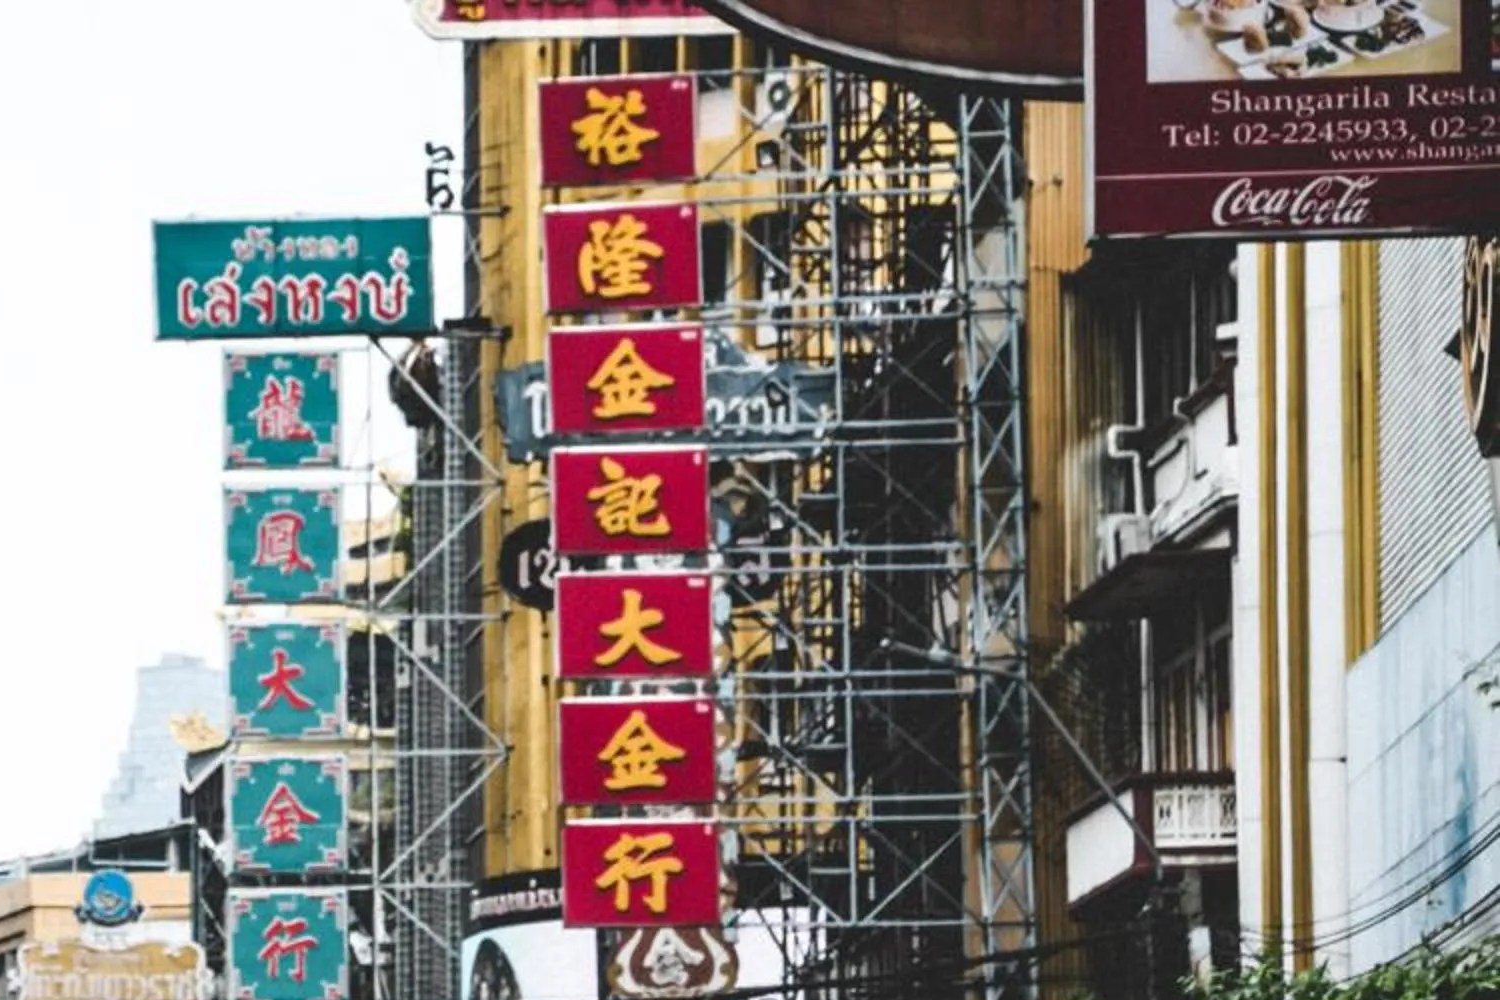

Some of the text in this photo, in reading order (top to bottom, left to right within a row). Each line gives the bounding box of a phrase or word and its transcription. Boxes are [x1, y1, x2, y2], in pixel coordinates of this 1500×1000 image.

[1211, 86, 1390, 118] Shangarila
[1162, 115, 1500, 148] Tel: 02-2245933, 02-2
